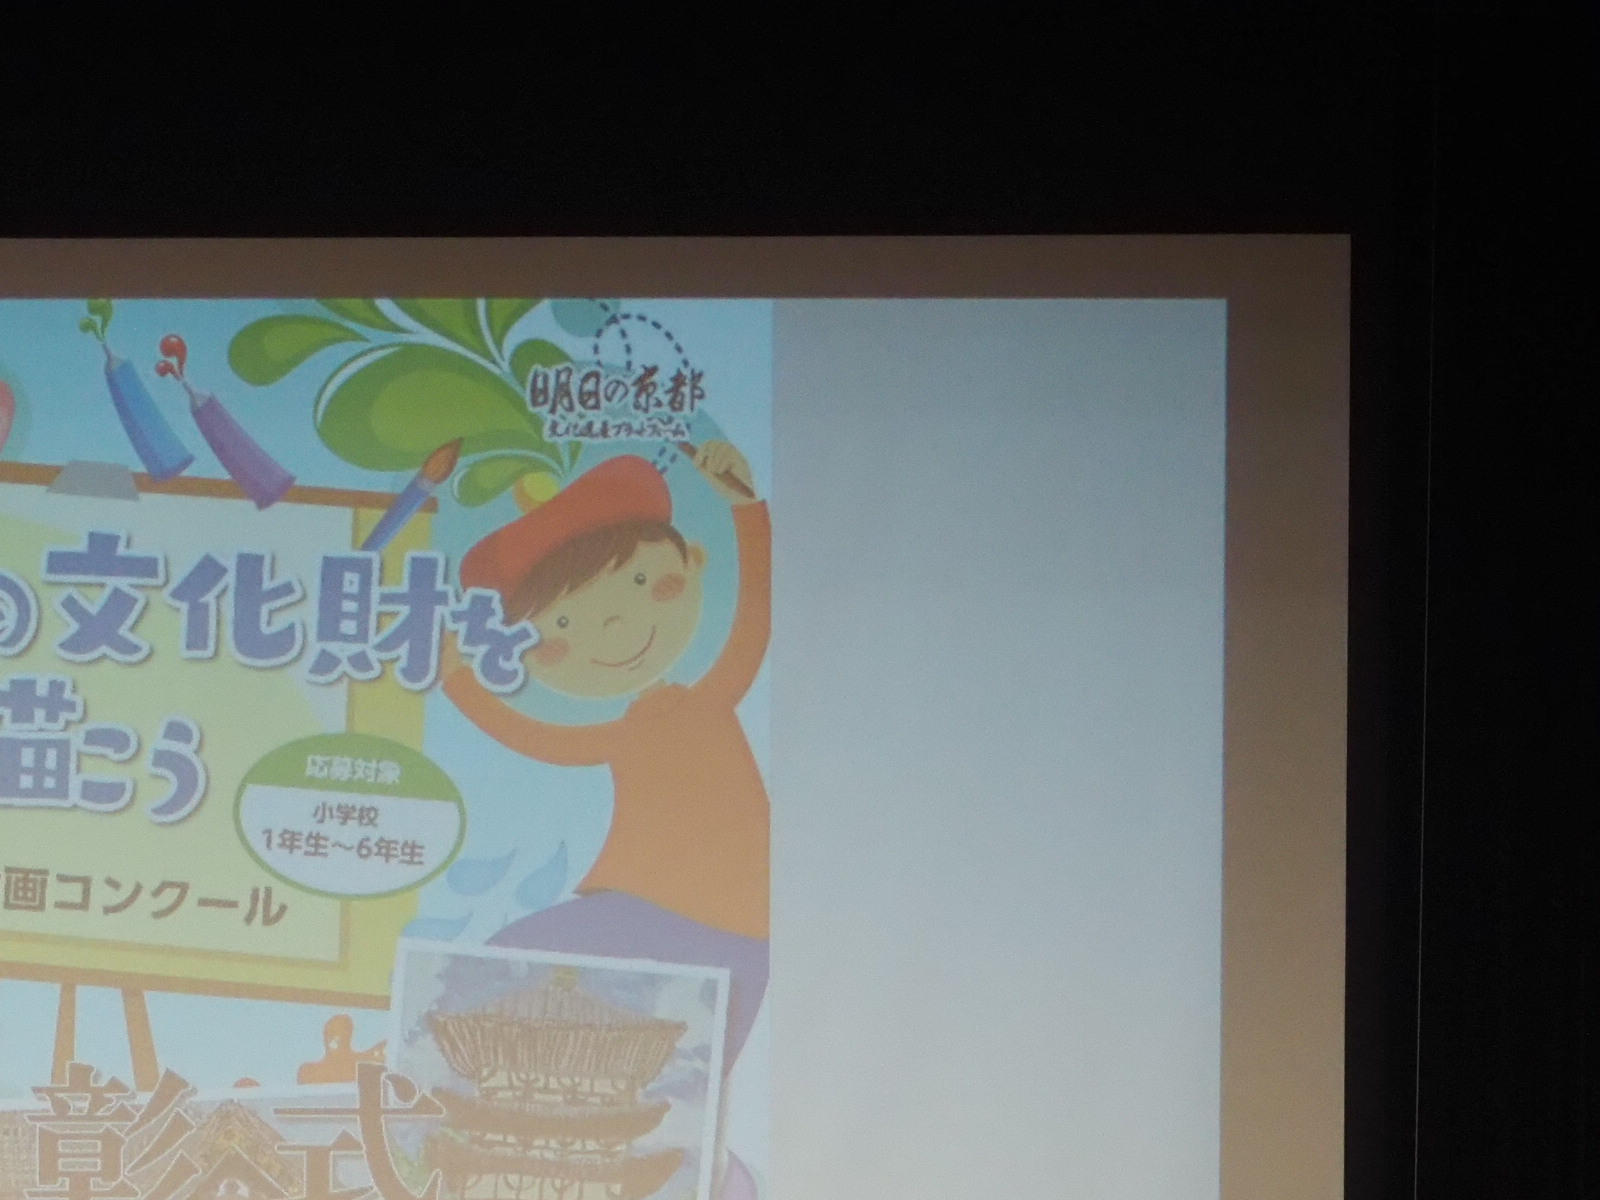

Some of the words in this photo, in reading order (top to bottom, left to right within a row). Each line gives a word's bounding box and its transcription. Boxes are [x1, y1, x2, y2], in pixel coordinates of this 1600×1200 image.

[530, 364, 706, 415] 明日の京都
[312, 801, 380, 828] 小学校
